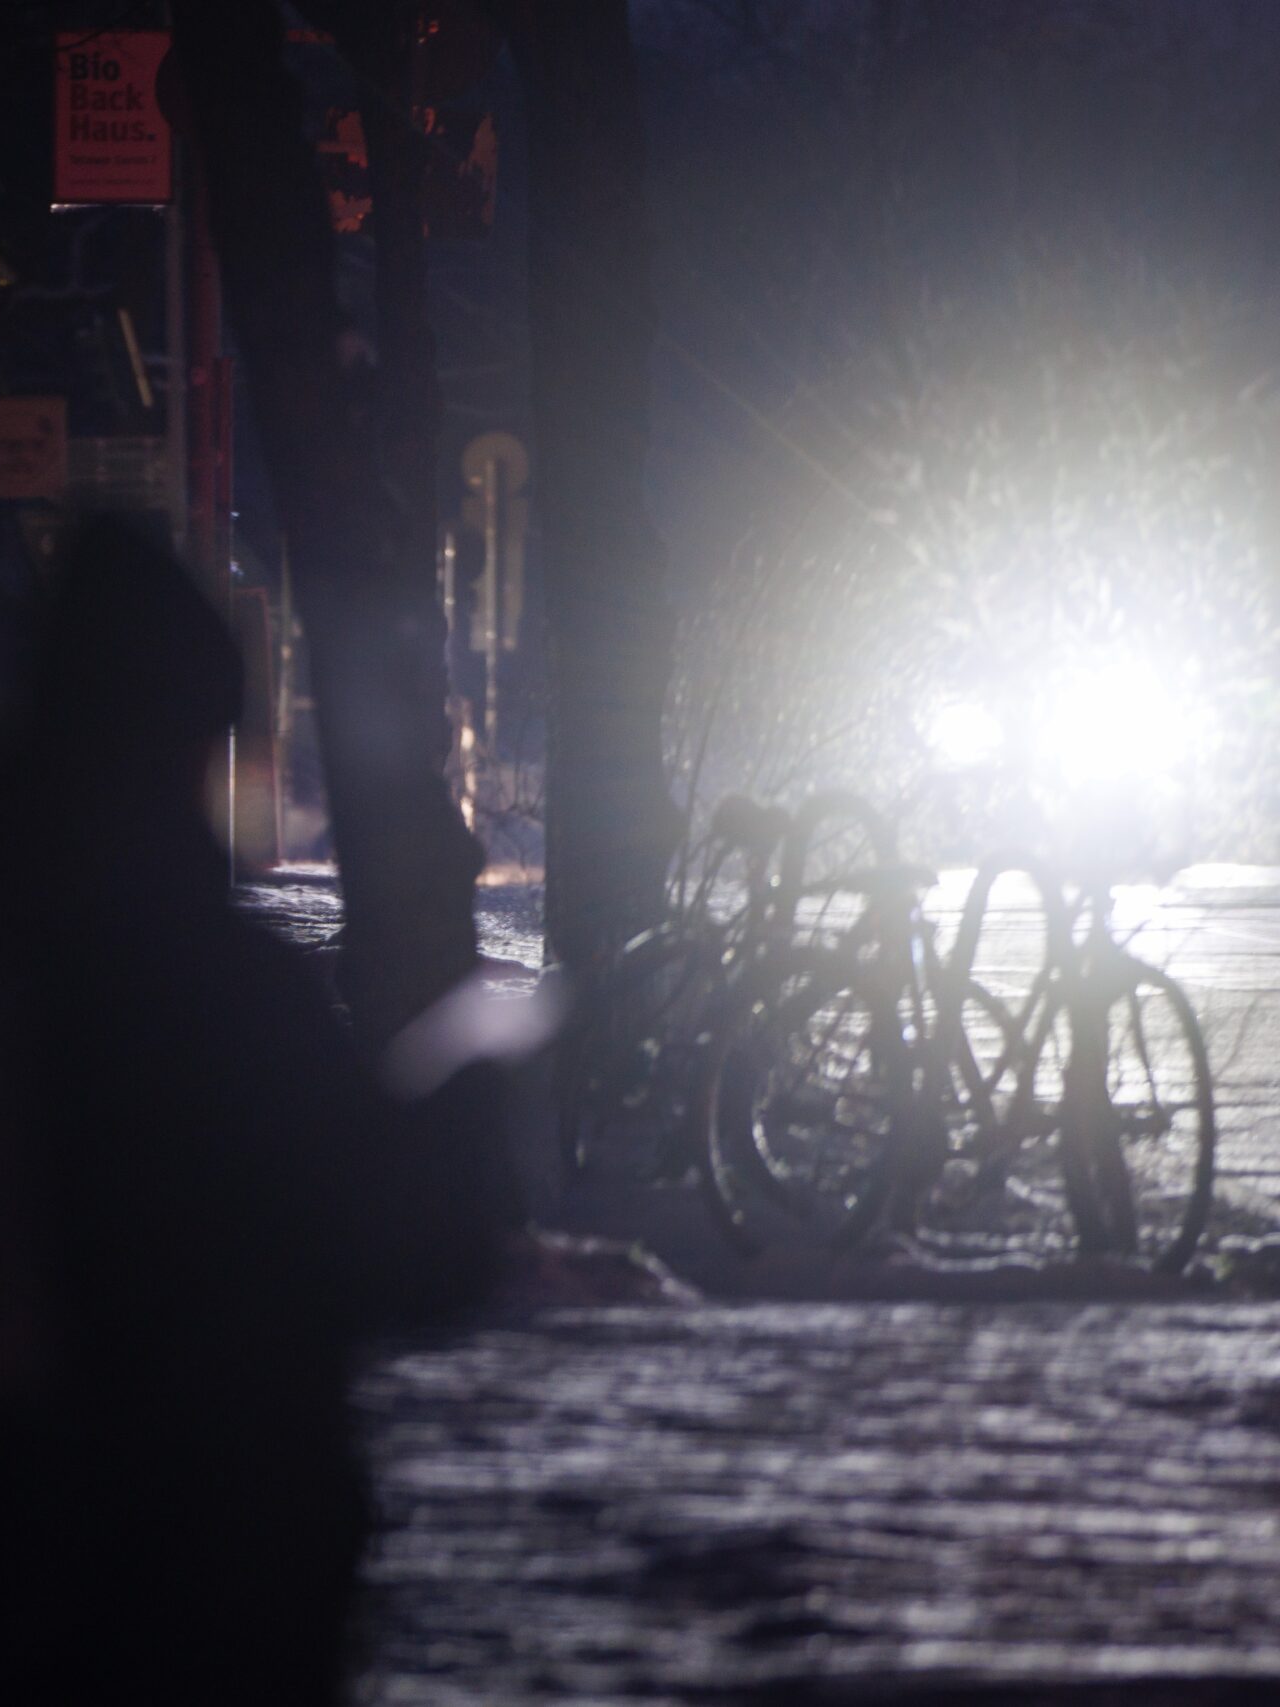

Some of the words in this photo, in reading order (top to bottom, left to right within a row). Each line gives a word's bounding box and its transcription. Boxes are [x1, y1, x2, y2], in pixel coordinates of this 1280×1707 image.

[70, 52, 120, 80] Bio
[71, 84, 143, 111] Back
[71, 115, 156, 141] Haus.
